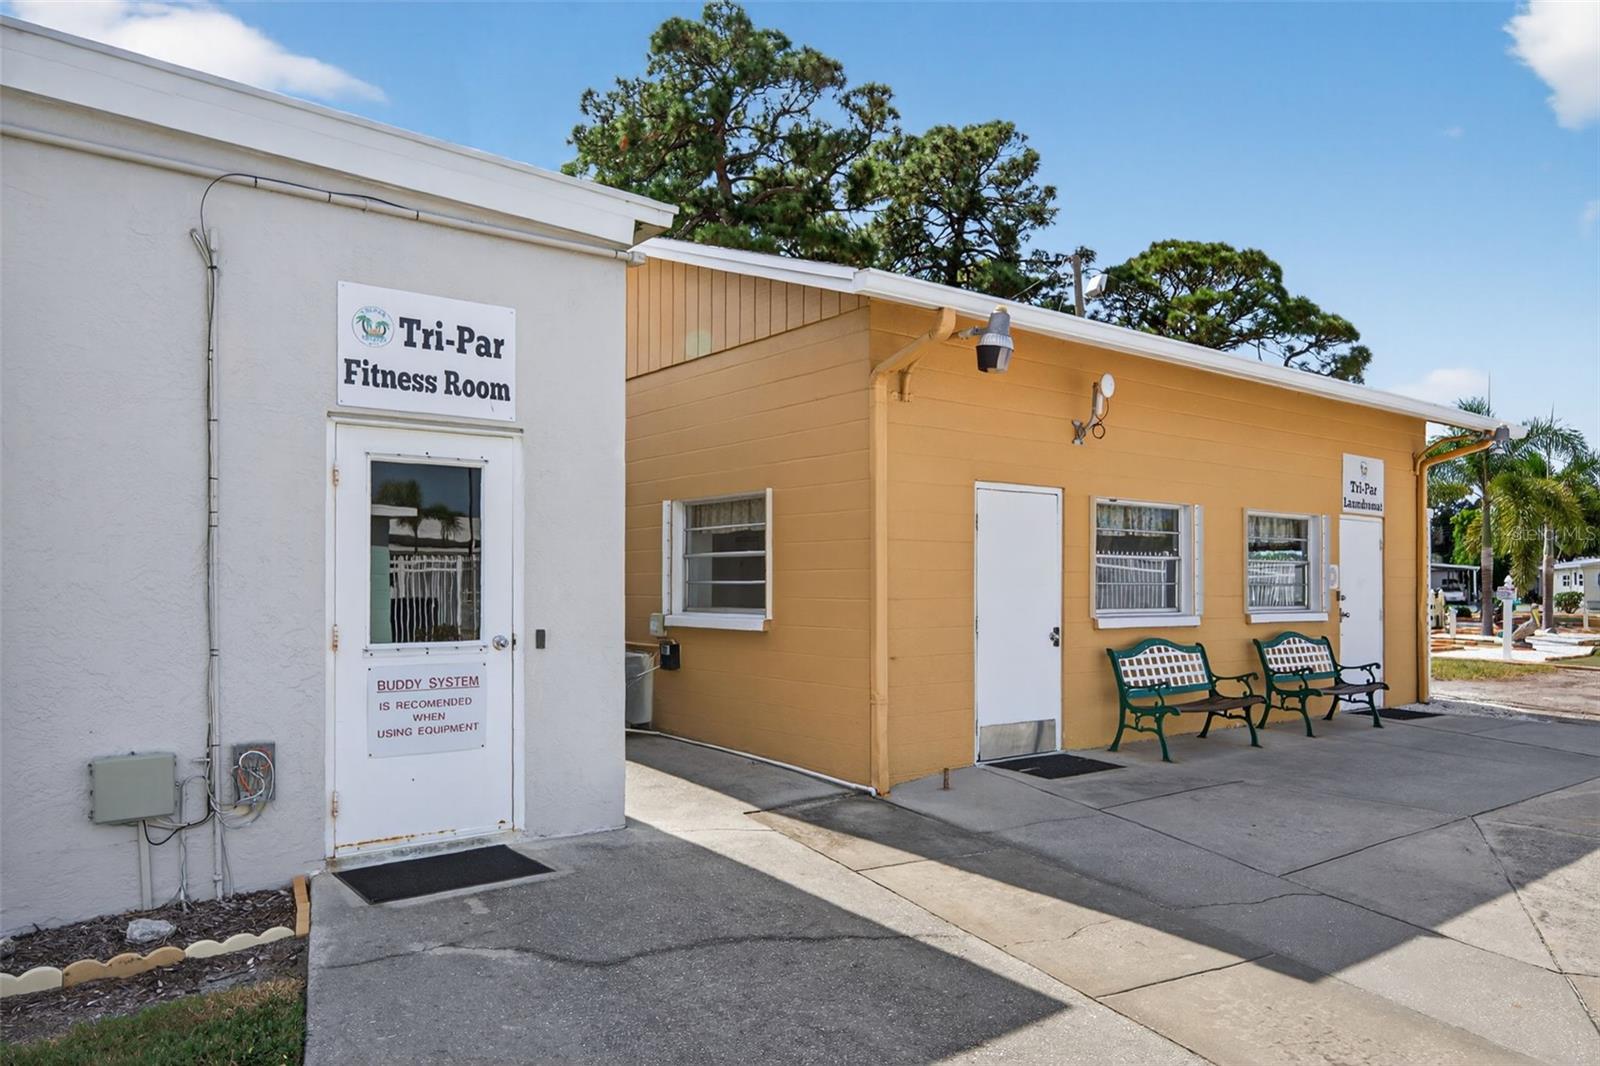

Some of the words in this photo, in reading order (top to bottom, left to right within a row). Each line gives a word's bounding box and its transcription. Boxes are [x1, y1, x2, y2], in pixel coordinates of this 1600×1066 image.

[399, 316, 505, 359] Tri-Par
[344, 358, 438, 394] Fitness
[444, 370, 511, 401] Room
[1350, 480, 1377, 496] Tri-Par
[377, 679, 422, 691] BUDDY
[429, 676, 480, 689] SYSTEM
[379, 702, 390, 711] IS
[396, 697, 472, 710] RECOMENDED
[413, 712, 446, 722] WHEN
[377, 728, 413, 739] USING
[418, 722, 480, 736] EQUIPMENT
